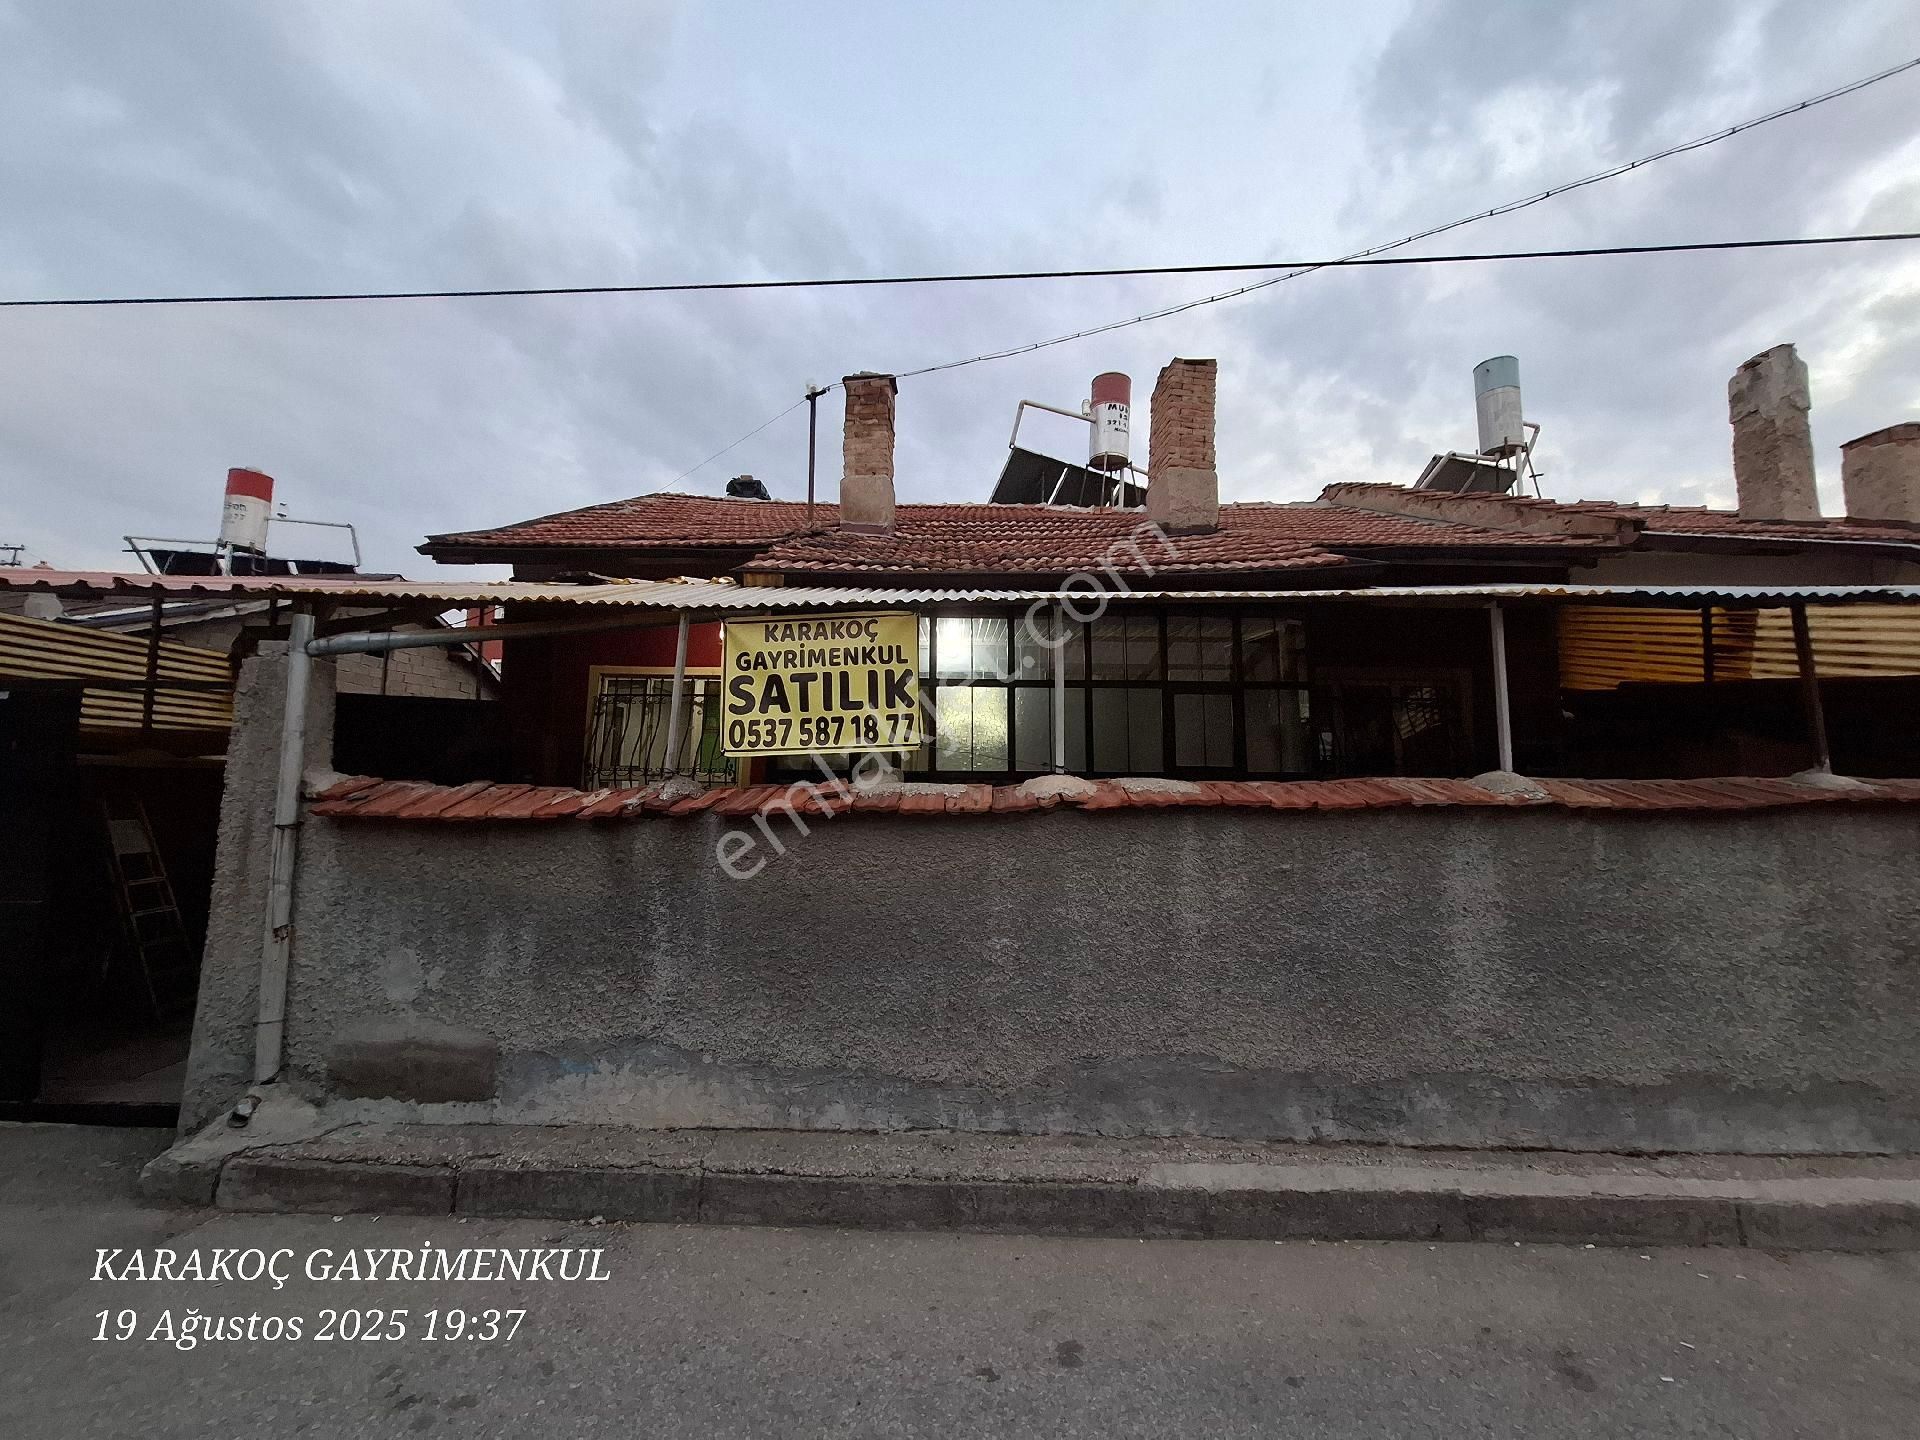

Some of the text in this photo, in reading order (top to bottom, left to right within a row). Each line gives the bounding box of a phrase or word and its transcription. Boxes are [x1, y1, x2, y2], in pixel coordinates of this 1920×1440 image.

[764, 617, 880, 643] KARAKOÇ
[736, 642, 909, 672] GAYRİMENKUL
[728, 667, 916, 716] SATILIK
[729, 712, 915, 749] 0537 587 18 77
